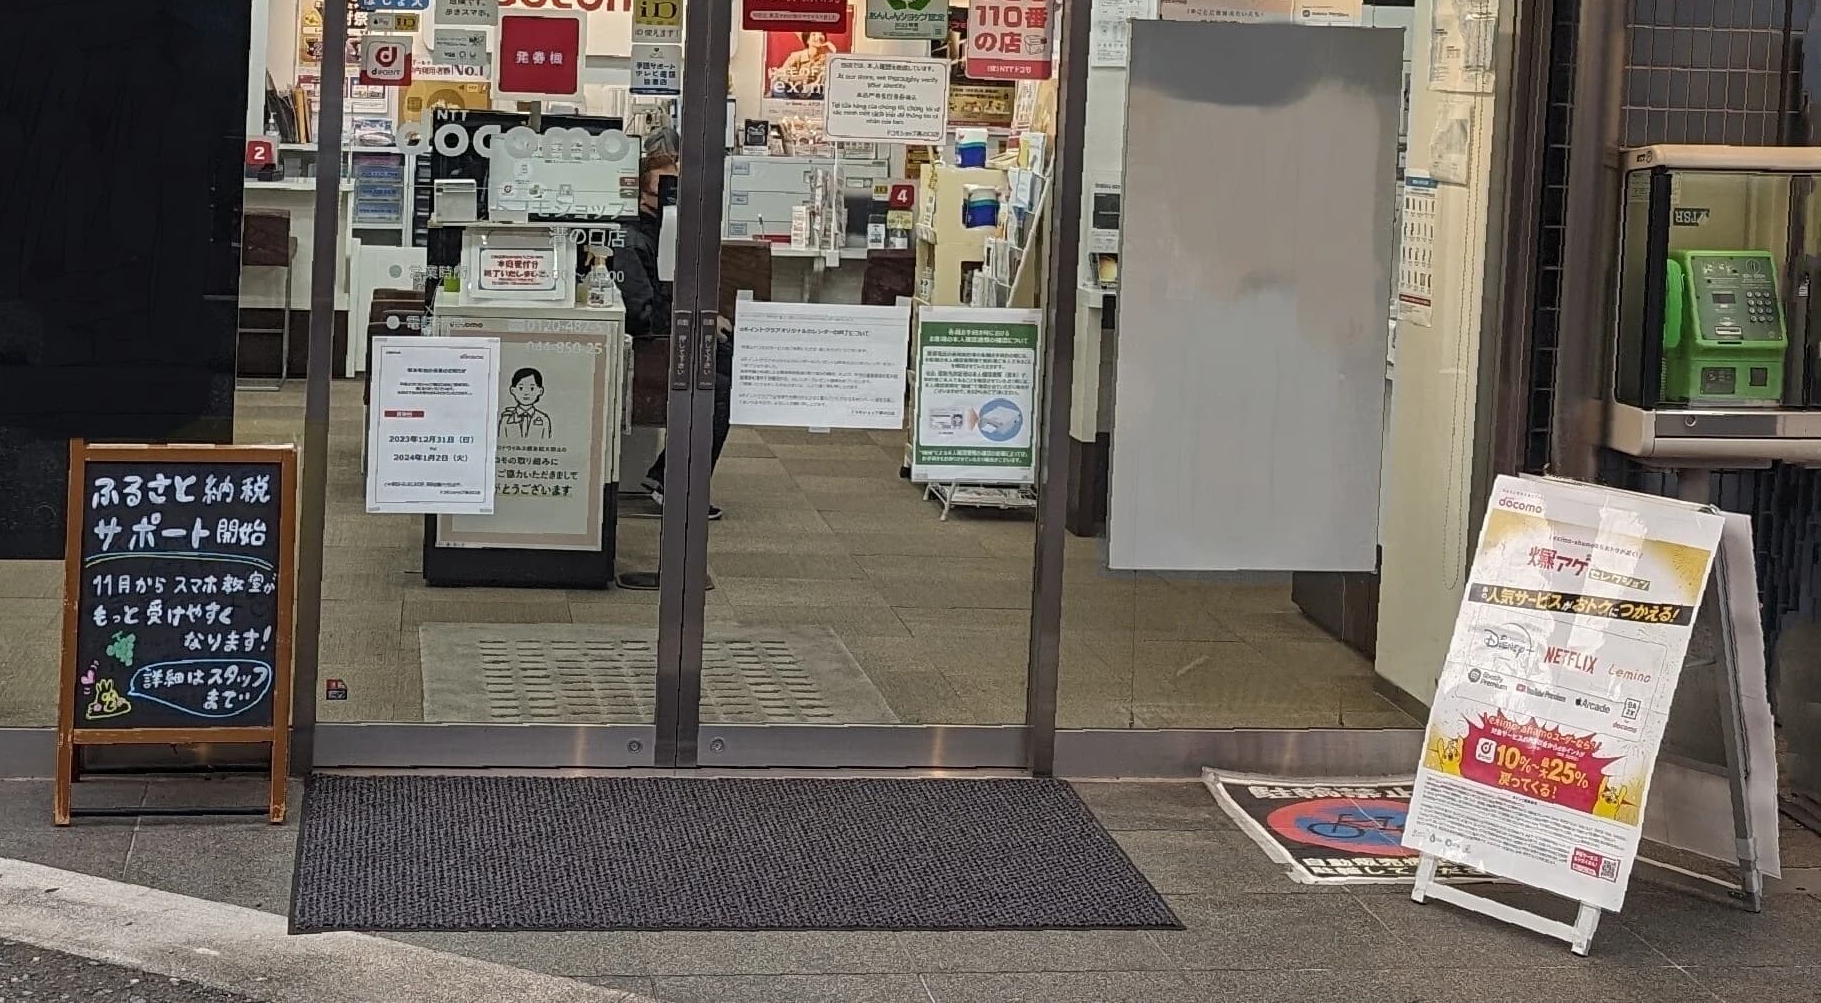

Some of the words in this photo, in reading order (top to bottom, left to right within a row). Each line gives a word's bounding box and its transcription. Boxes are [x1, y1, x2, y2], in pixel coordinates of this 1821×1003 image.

[640, 1, 677, 18] iD
[975, 5, 1048, 28] 110番
[975, 31, 1022, 54] の店
[516, 52, 563, 64] 発券機
[437, 110, 469, 121] NTT
[396, 109, 630, 161] docomo
[253, 147, 266, 160] 2
[897, 190, 908, 203] 4
[91, 473, 270, 509] ふるさと納税
[1499, 496, 1542, 514] docomo
[94, 512, 267, 551] サポート開始
[1589, 570, 1650, 591] セレクション
[93, 599, 234, 626] もっと受けやすく
[184, 626, 272, 652] なります!
[1544, 646, 1597, 674] NETFLIX
[143, 665, 269, 688] 詳細はスタッフ
[1609, 664, 1651, 684] Lemino
[1582, 699, 1611, 714] Arcade
[1499, 771, 1558, 799] 戻ってくる!
